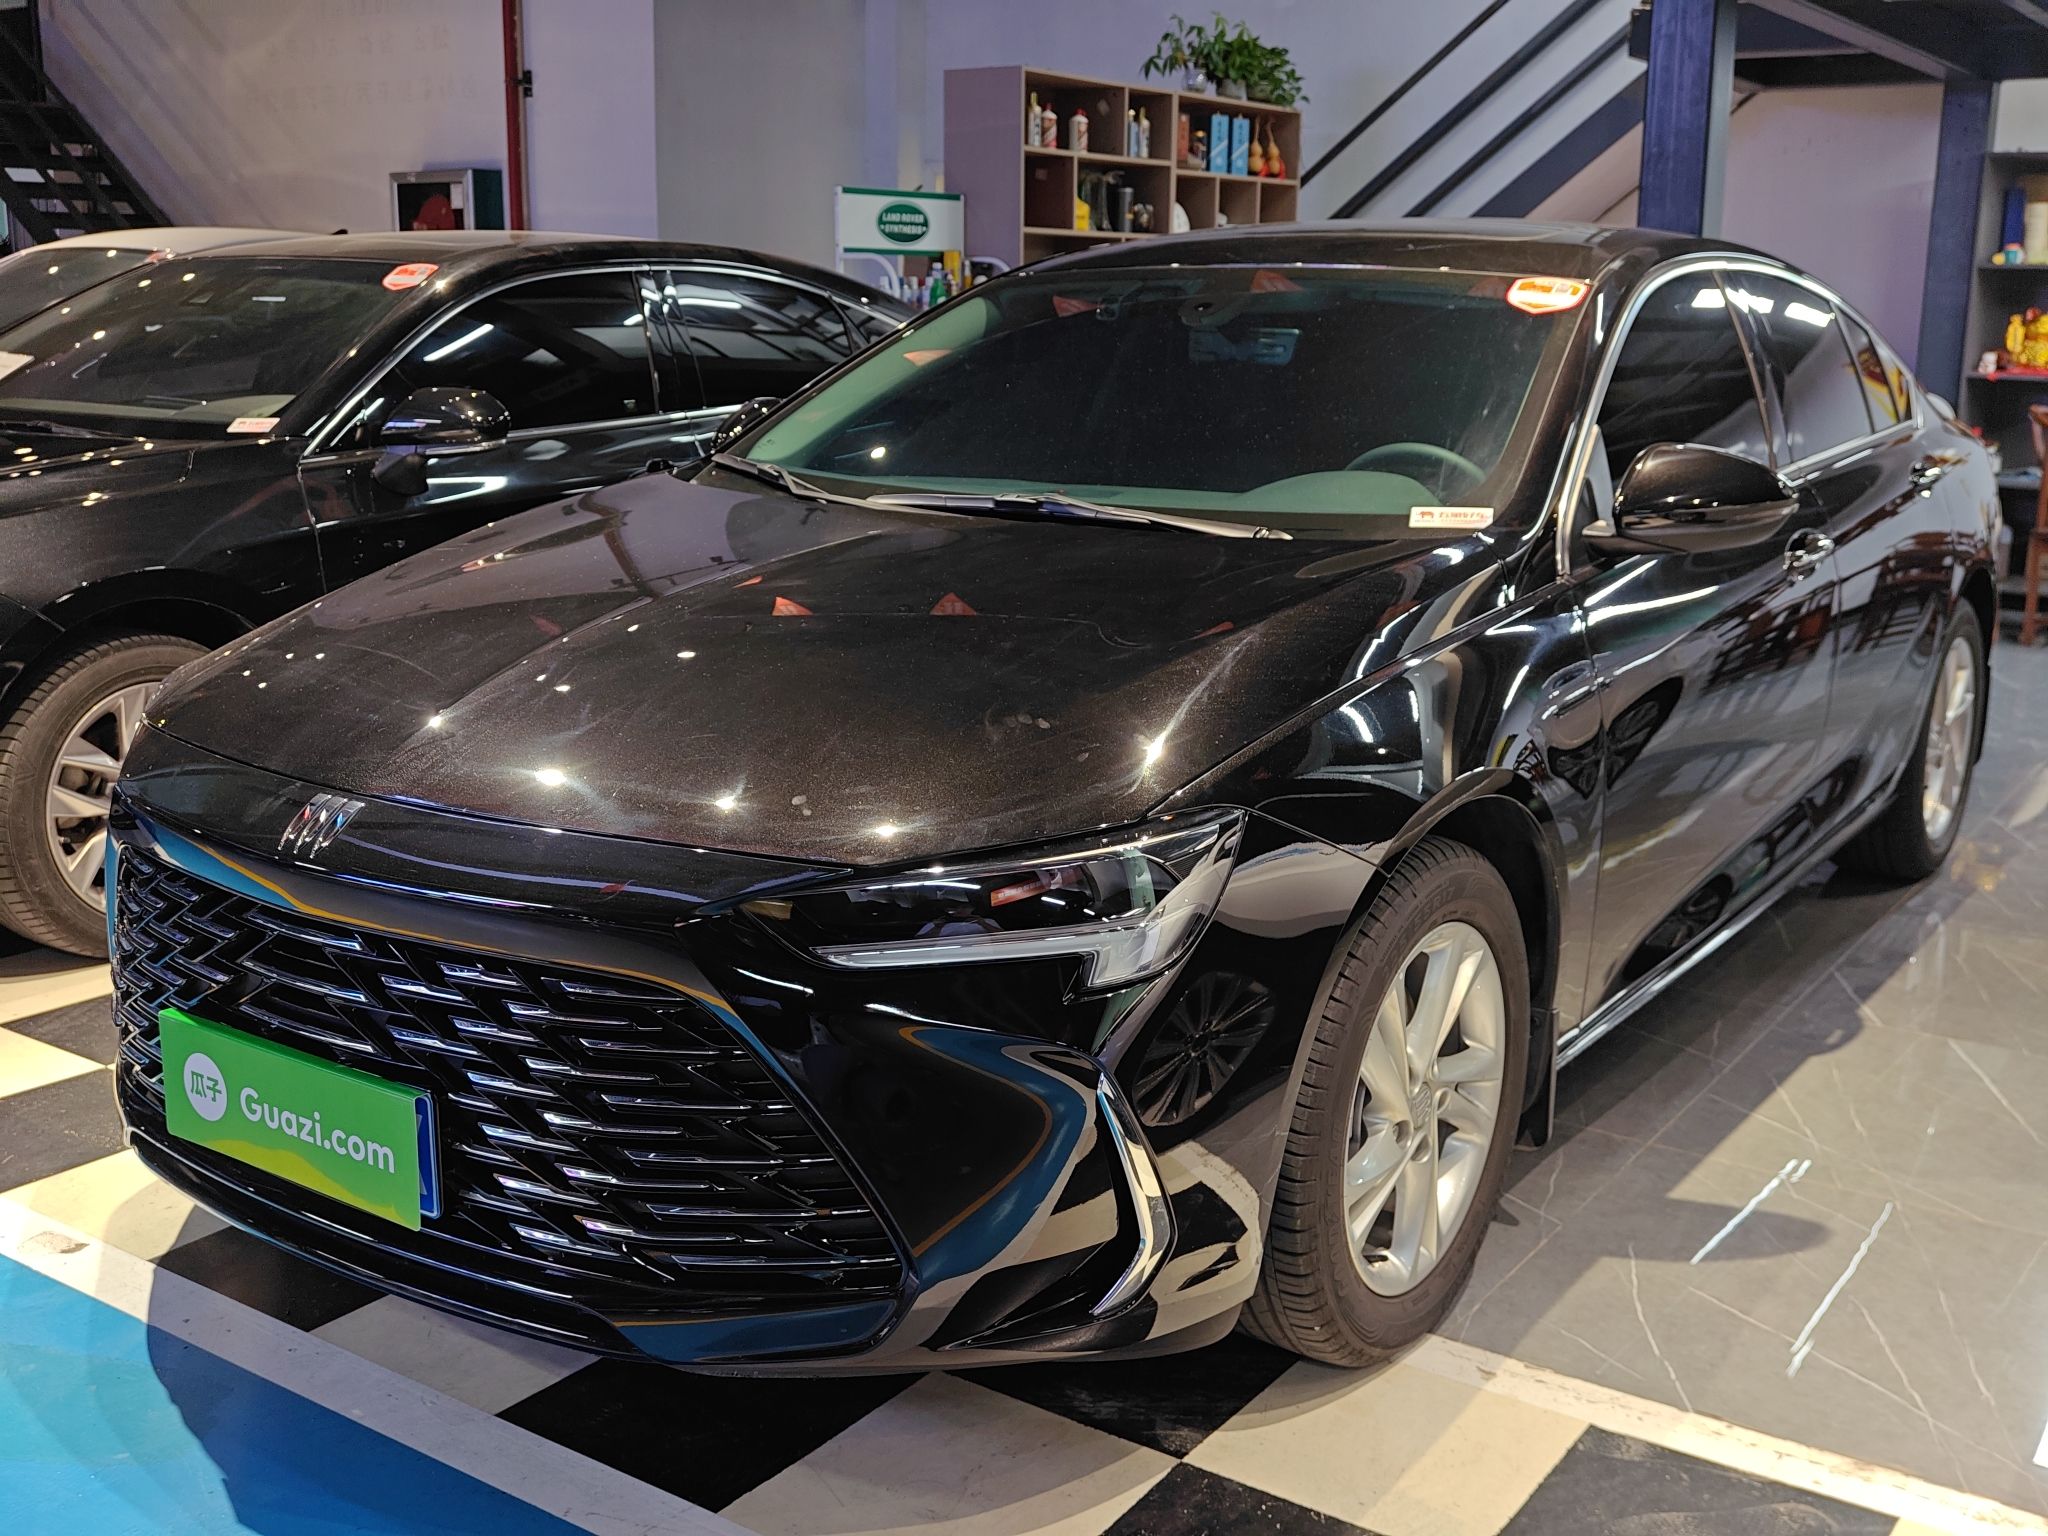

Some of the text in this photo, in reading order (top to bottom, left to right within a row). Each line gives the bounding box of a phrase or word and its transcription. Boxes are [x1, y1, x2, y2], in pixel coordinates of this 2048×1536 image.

[882, 212, 924, 223] LAND ROVER
[190, 1070, 222, 1103] 瓜子
[240, 1087, 395, 1174] Guazi.com
